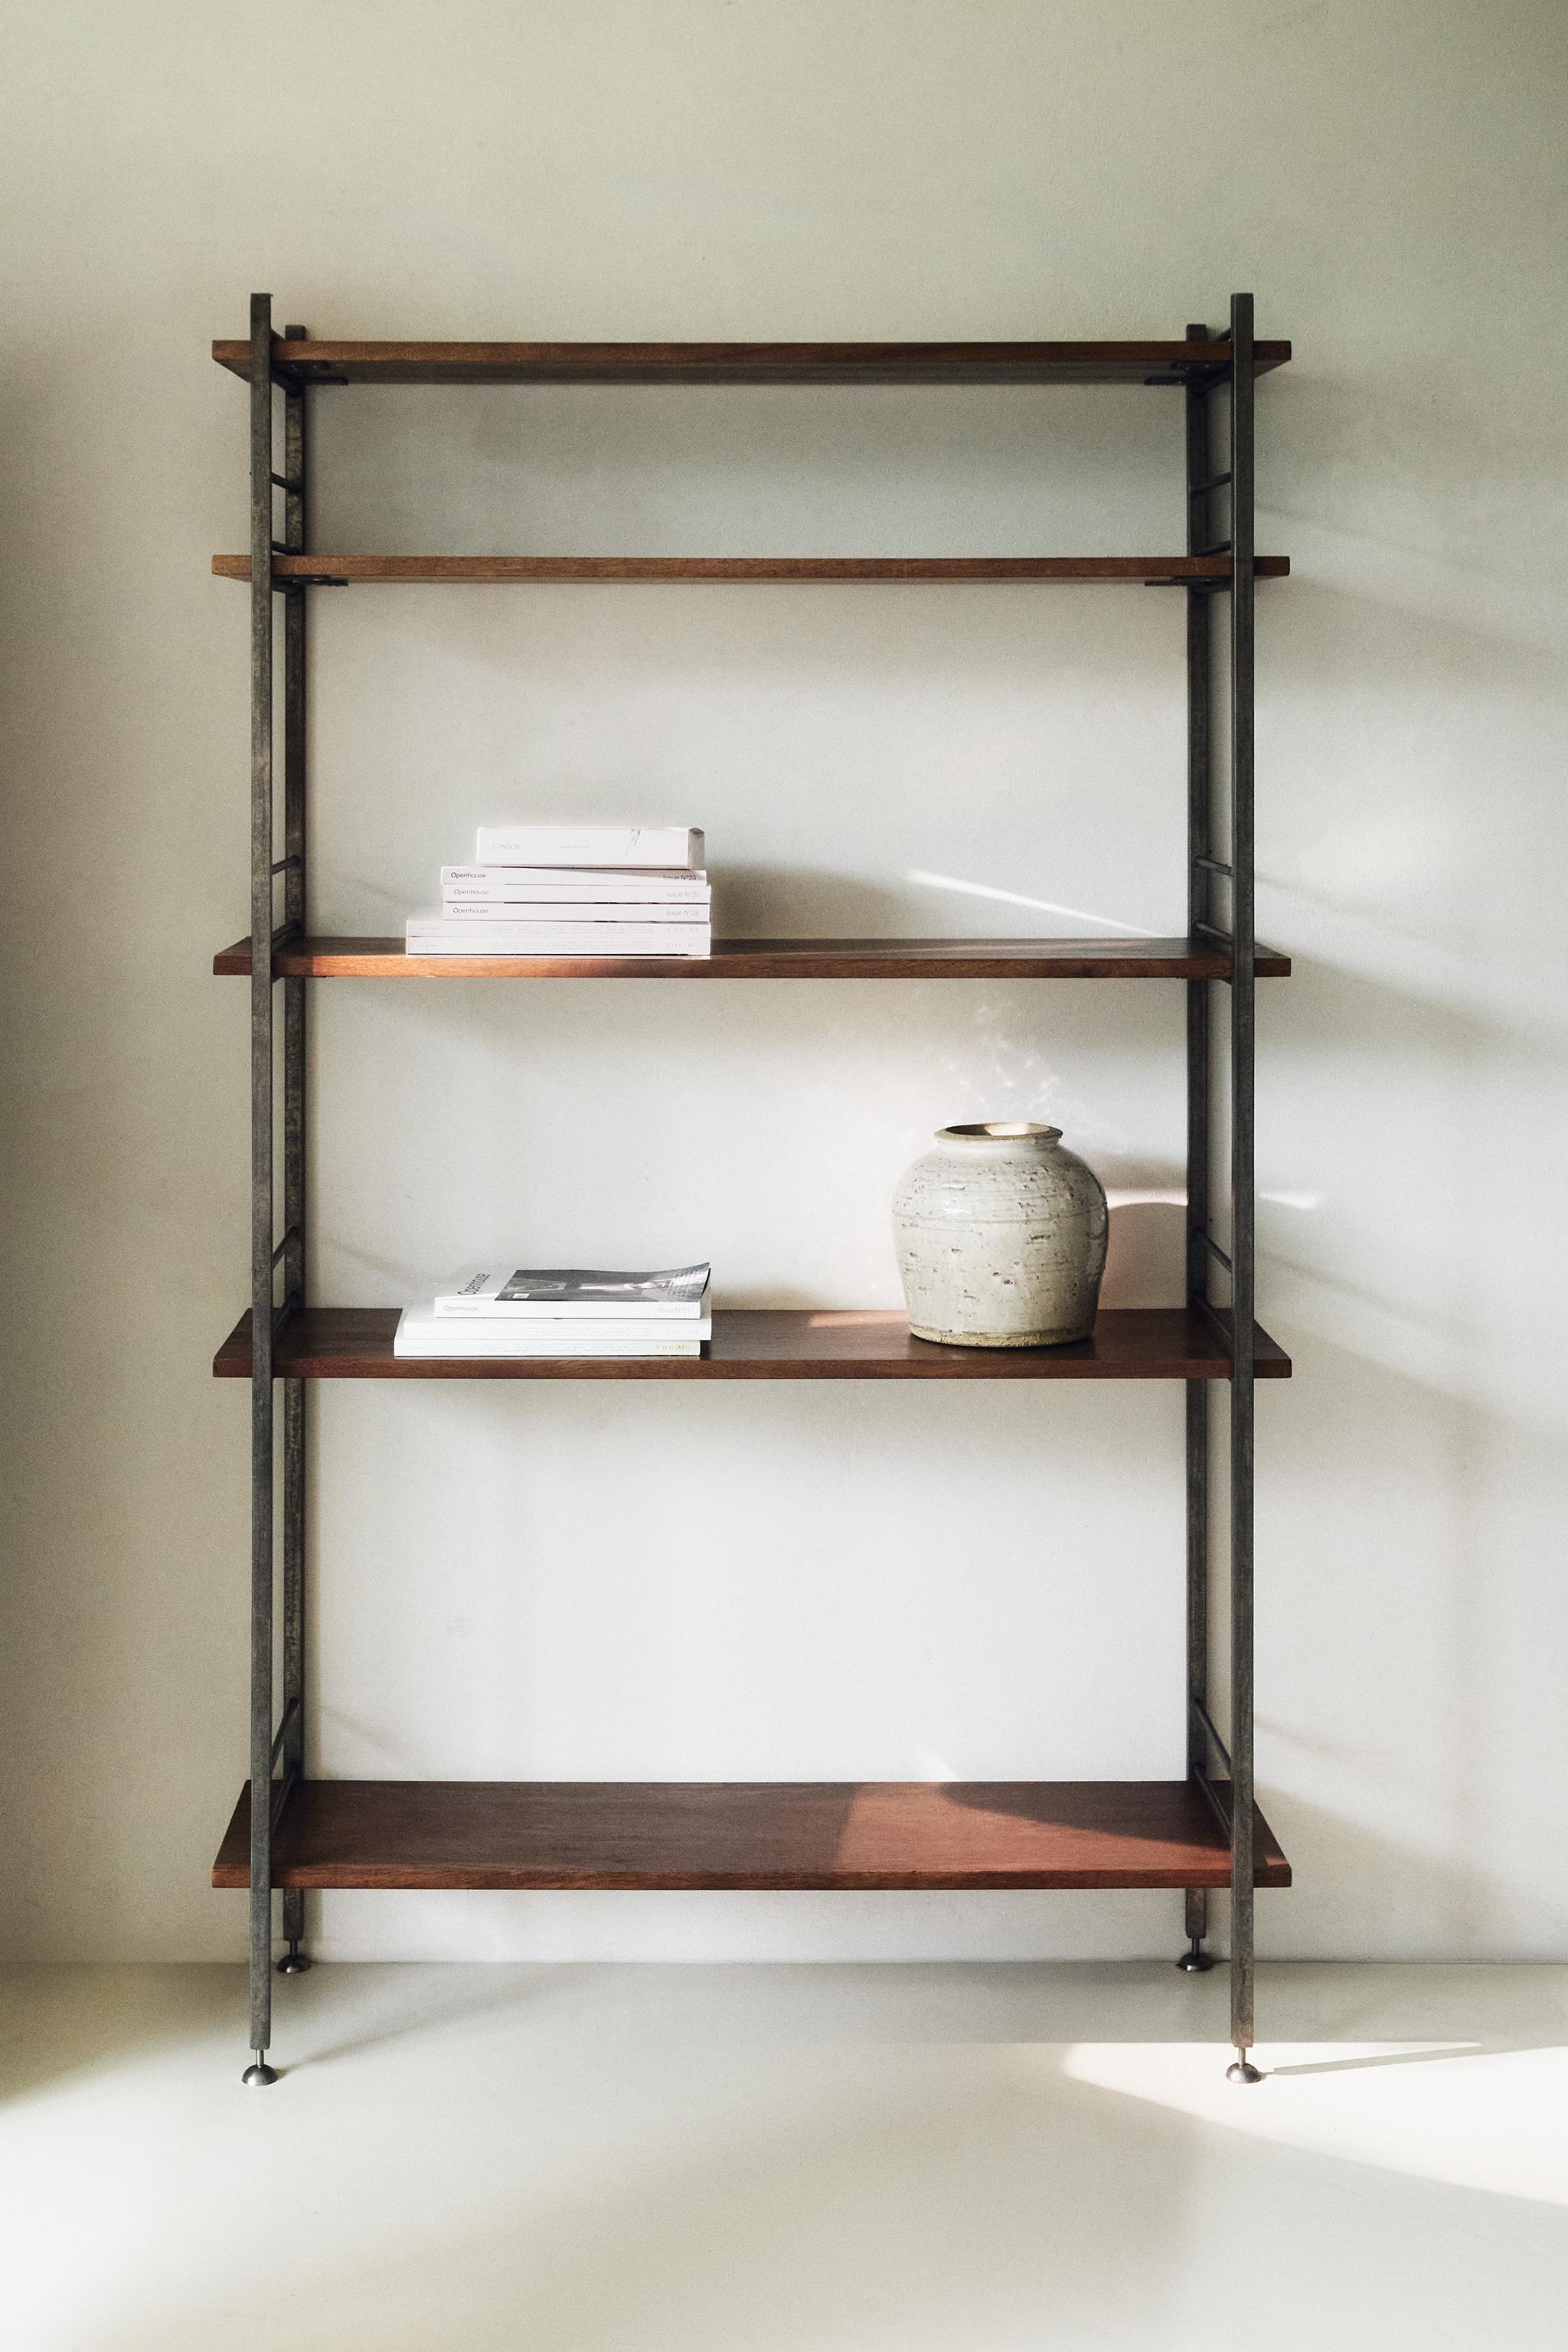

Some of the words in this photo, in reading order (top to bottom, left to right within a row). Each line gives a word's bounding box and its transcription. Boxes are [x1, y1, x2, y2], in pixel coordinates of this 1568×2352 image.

[450, 871, 486, 880] Openhouse
[453, 888, 490, 897] Openhouse
[452, 906, 488, 915] Openhouse
[443, 1305, 479, 1313] Openhouse
